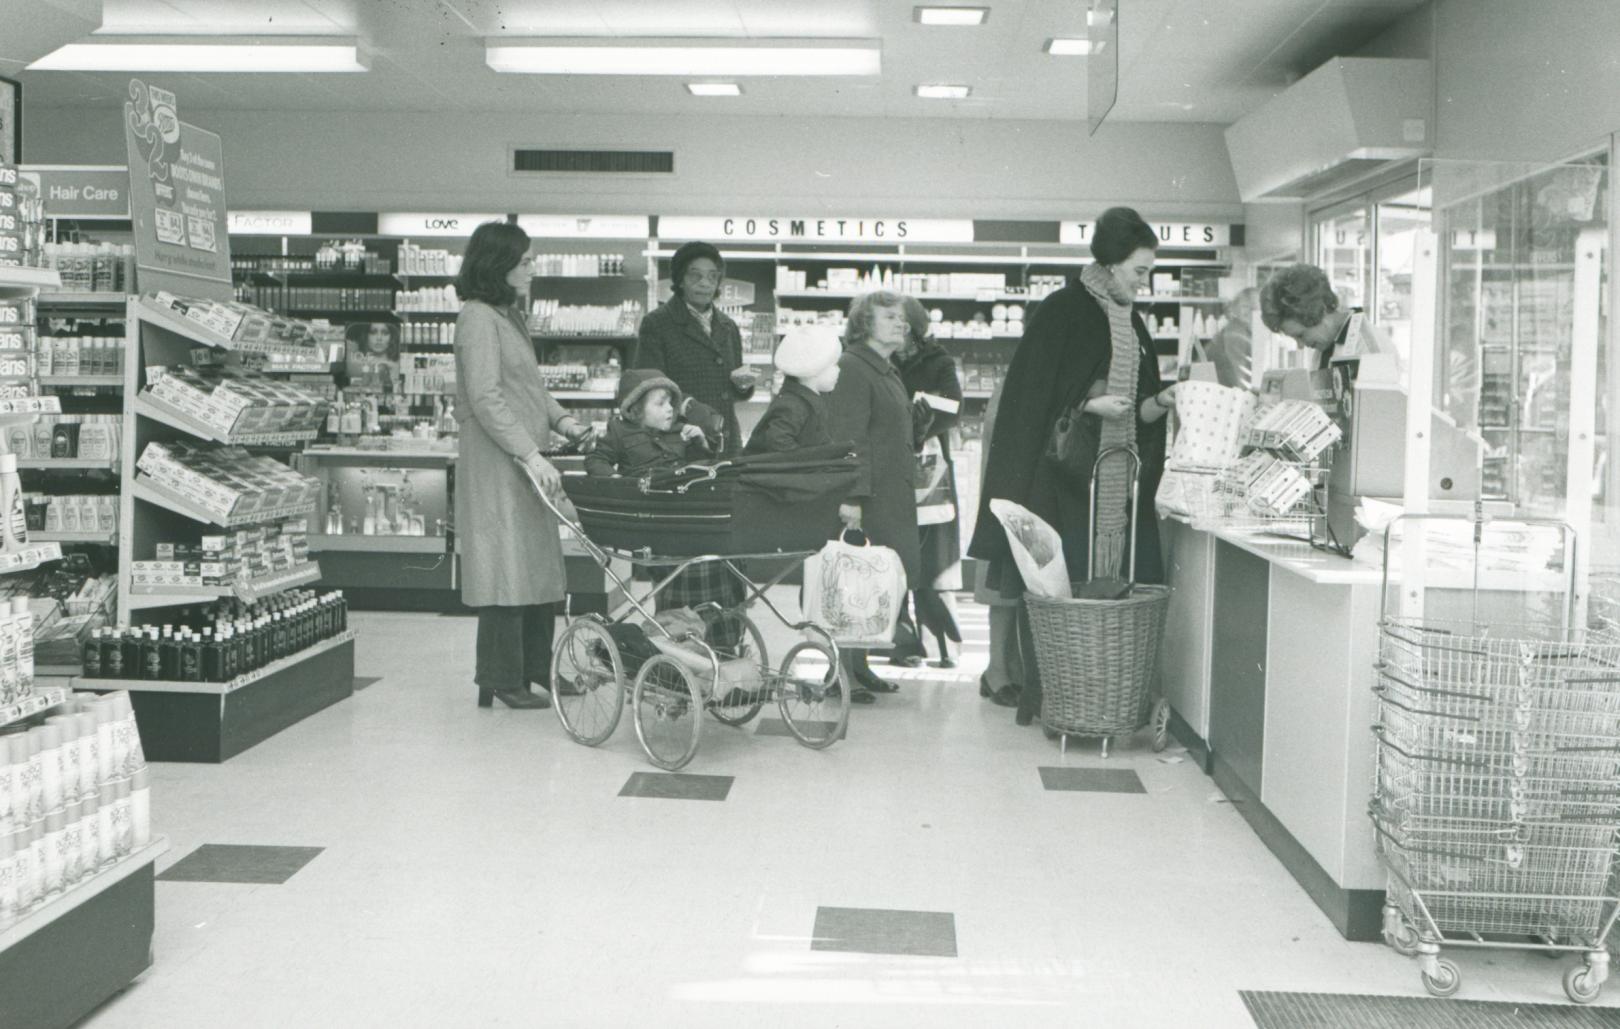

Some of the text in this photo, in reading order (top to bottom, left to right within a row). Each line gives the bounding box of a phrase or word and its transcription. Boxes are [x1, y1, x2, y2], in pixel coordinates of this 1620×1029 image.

[50, 186, 79, 200] Hair
[82, 186, 118, 201] Care
[724, 218, 908, 238] COSMETICS
[1078, 224, 1214, 243] TUES
